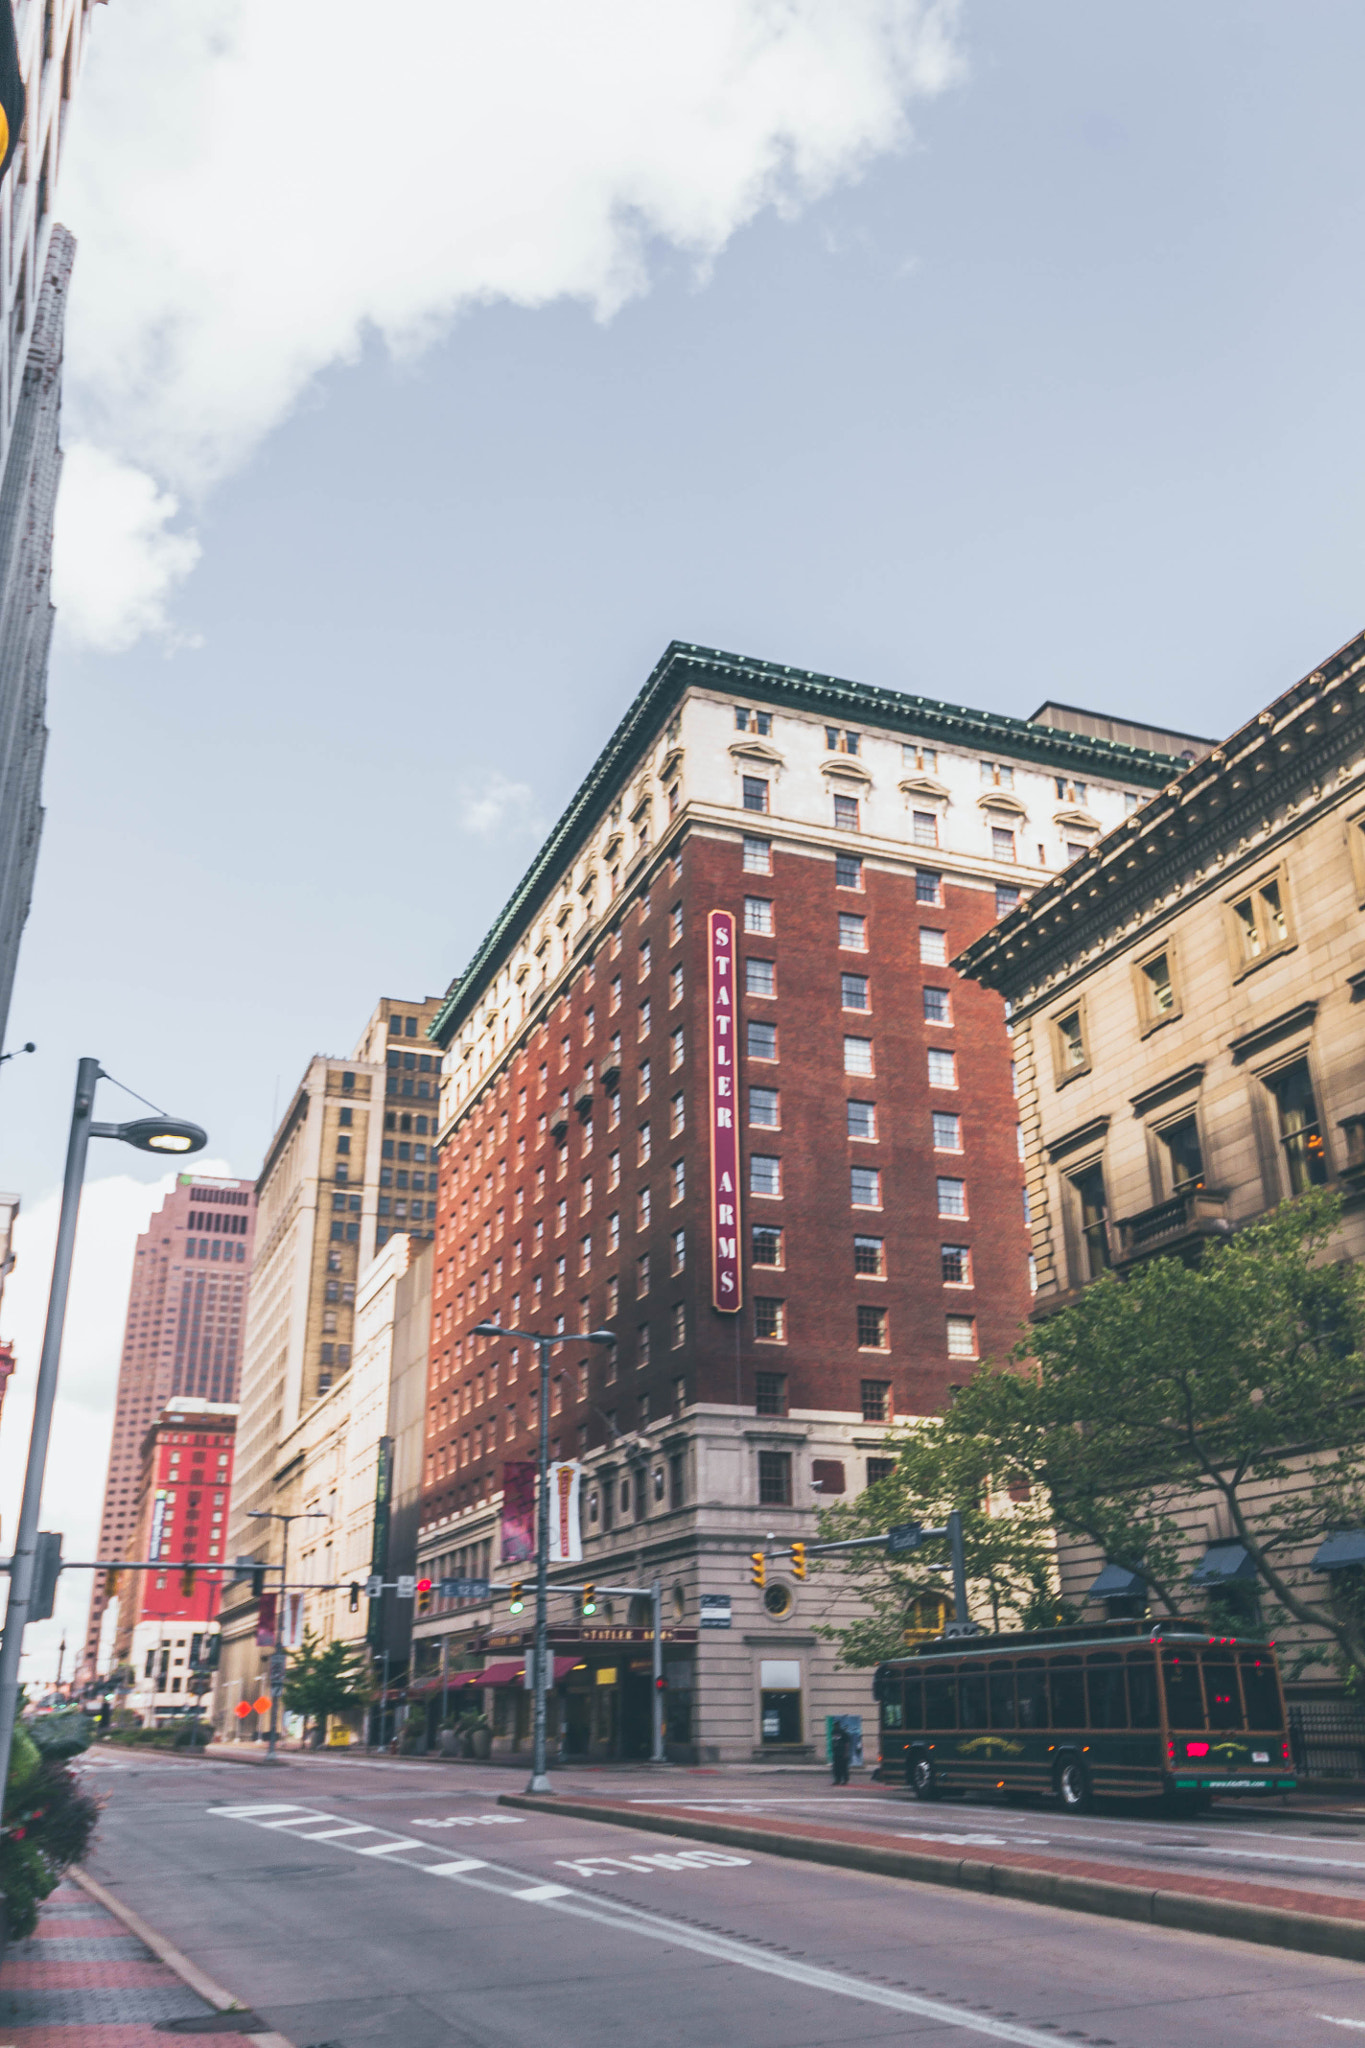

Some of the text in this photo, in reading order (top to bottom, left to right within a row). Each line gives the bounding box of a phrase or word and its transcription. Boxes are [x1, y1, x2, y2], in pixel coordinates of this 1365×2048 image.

[715, 926, 736, 1295] STATLER ARMS
[554, 1850, 752, 1877] ONLY
